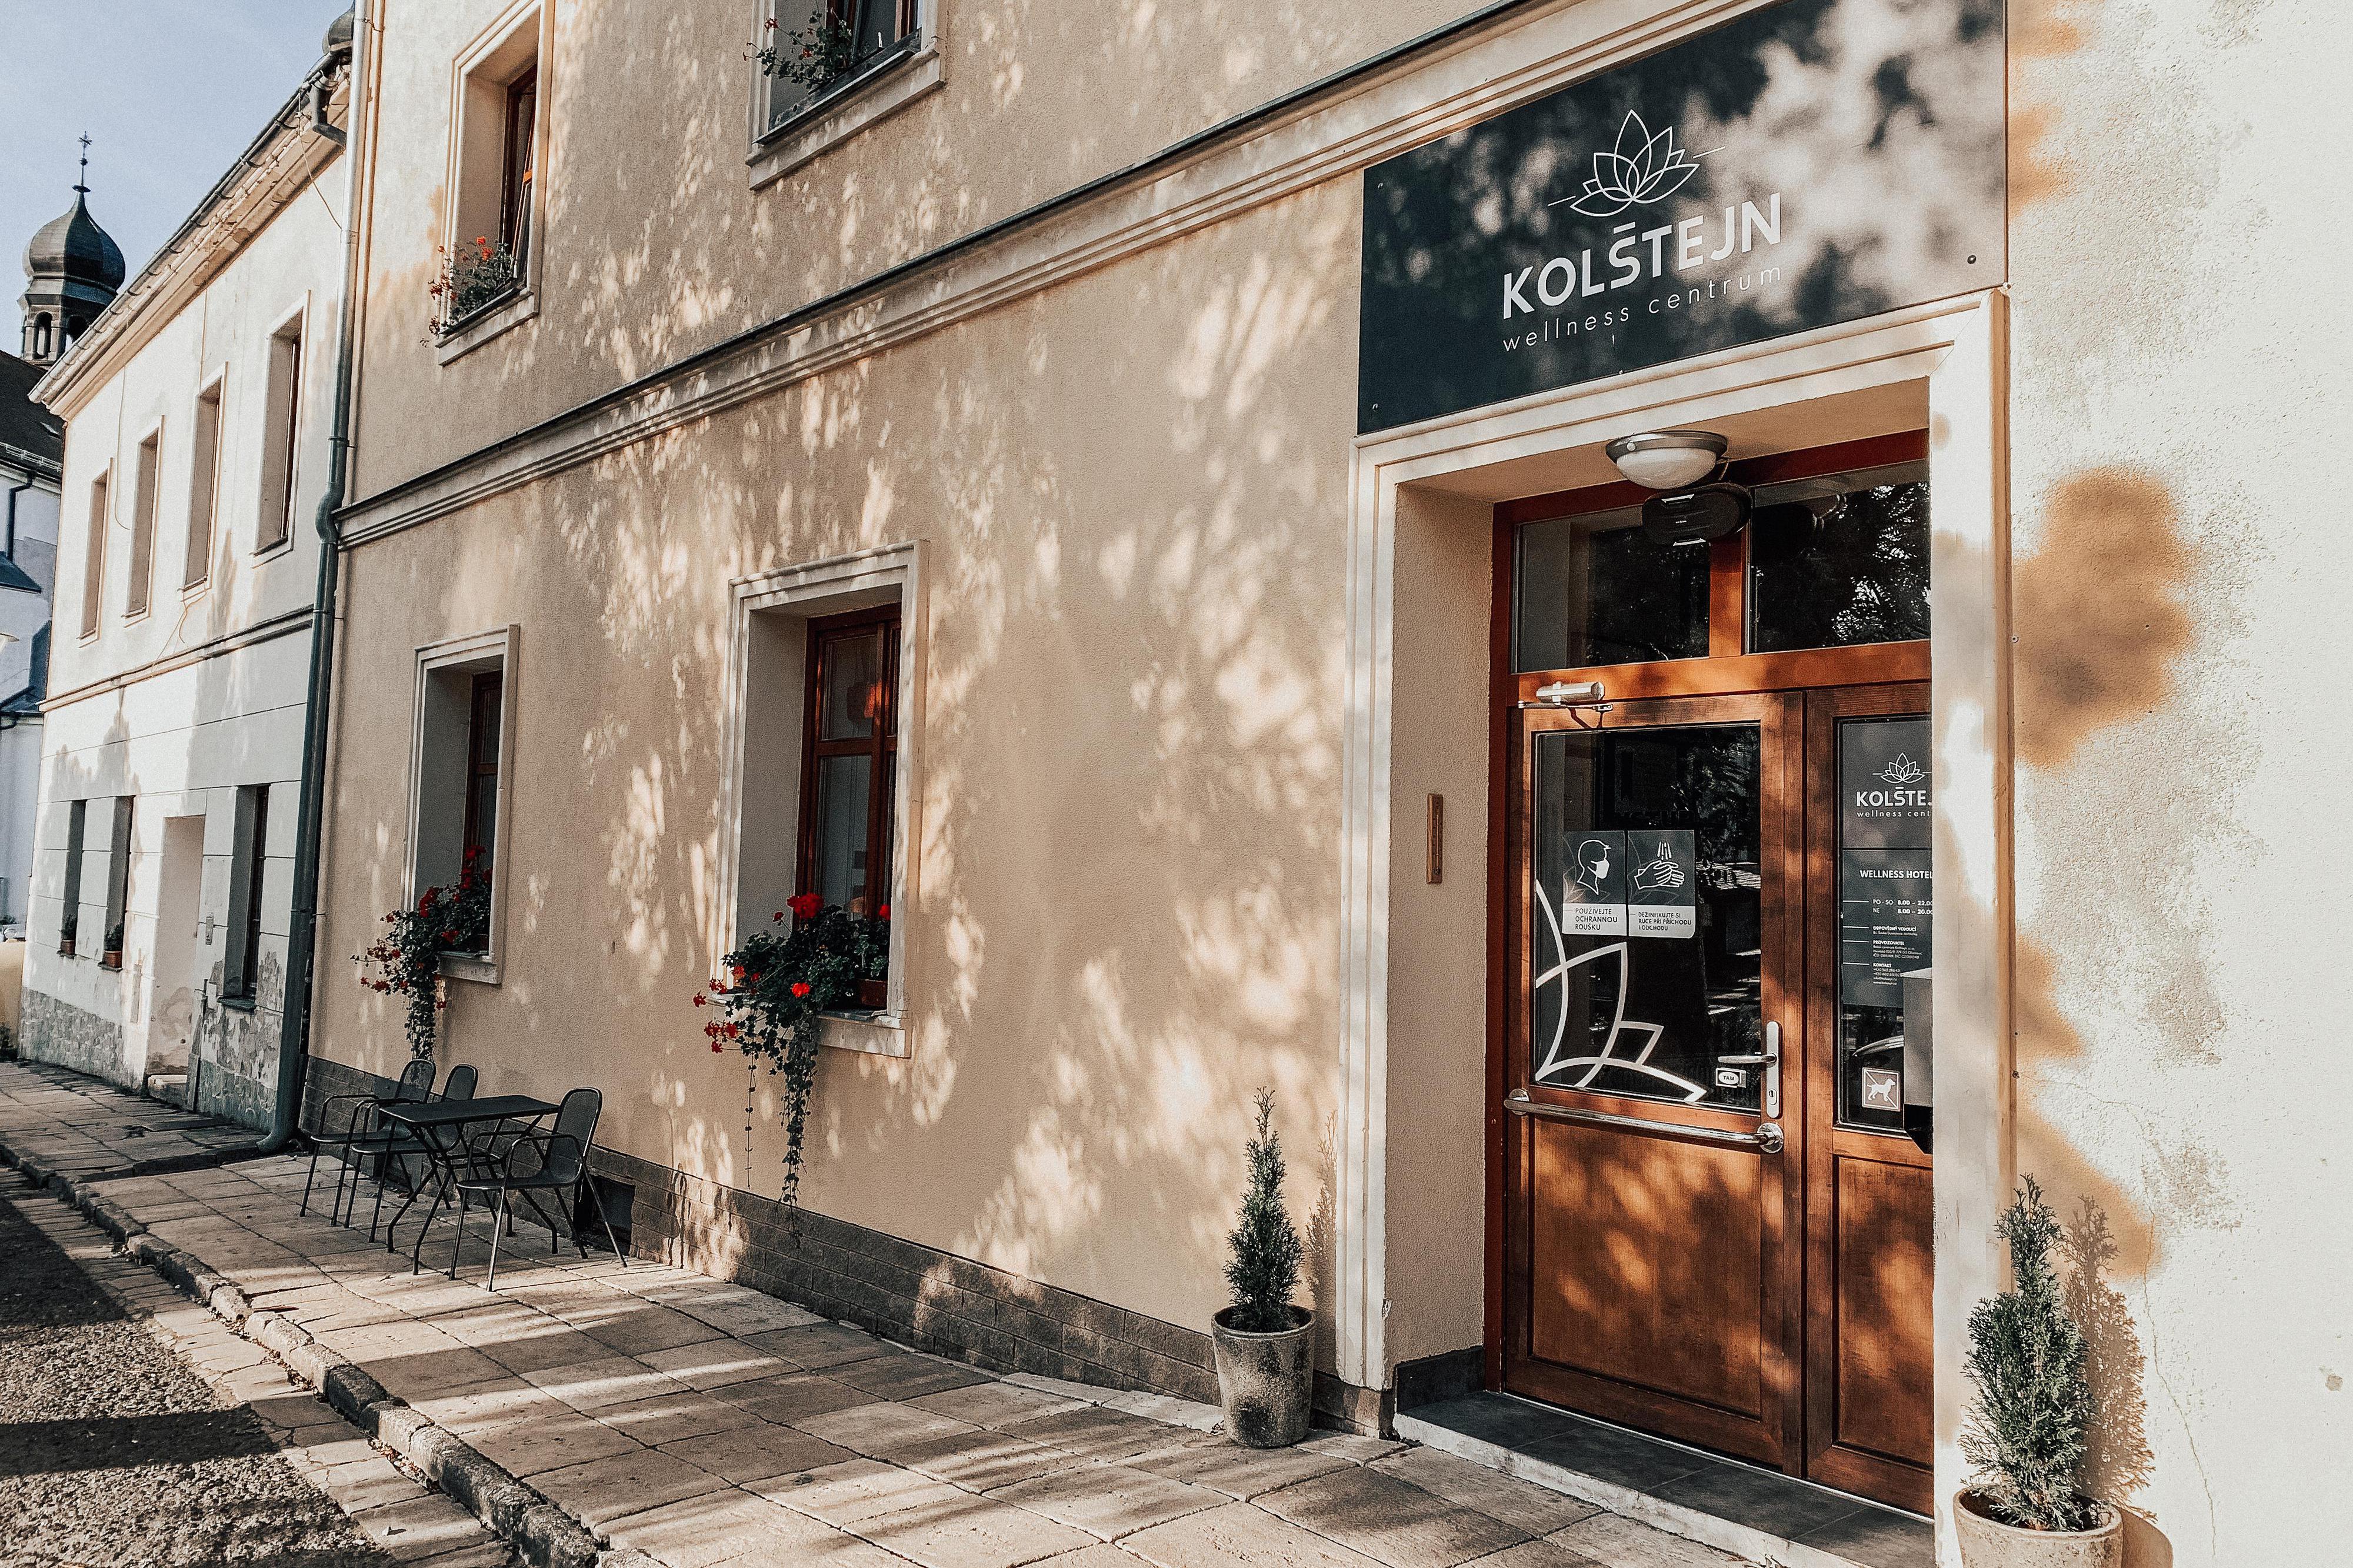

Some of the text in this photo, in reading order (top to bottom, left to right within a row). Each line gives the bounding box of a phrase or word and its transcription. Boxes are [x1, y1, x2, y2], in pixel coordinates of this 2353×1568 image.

[1503, 267, 1781, 352] wellness centrum
[1857, 786, 1932, 806] KOLŠTE
[1859, 870, 1904, 879] WELLNESS
[1575, 906, 1612, 915] POUŽÍVEJTE
